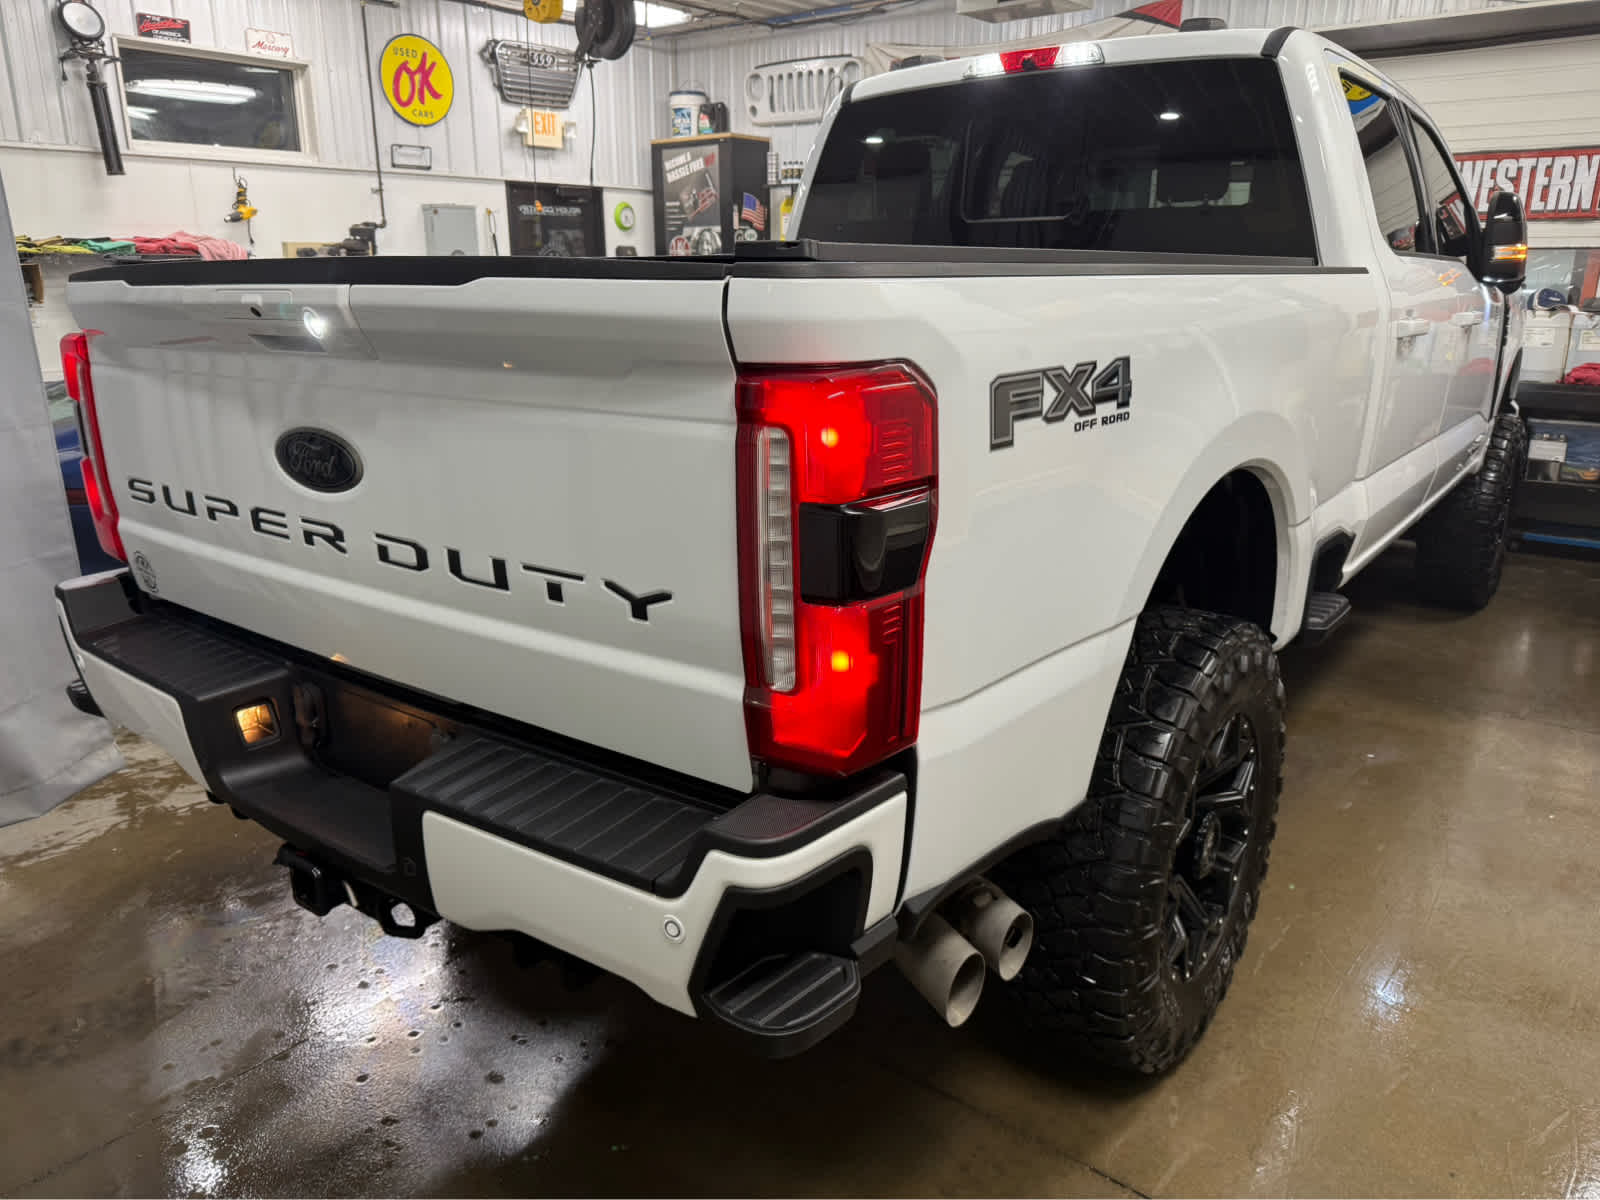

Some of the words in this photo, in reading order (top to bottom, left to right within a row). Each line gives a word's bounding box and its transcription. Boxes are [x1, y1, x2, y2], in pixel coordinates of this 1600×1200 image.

[393, 47, 418, 59] USED
[393, 51, 443, 109] OK
[412, 108, 435, 119] CARS
[533, 111, 557, 137] EXIT
[1456, 154, 1600, 212] WESTERN
[990, 356, 1132, 452] FX4
[1074, 418, 1098, 433] OFF
[1101, 411, 1130, 426] ROAD
[286, 440, 338, 479] Ford
[127, 477, 348, 555] SUPER
[374, 532, 673, 622] DUTY
